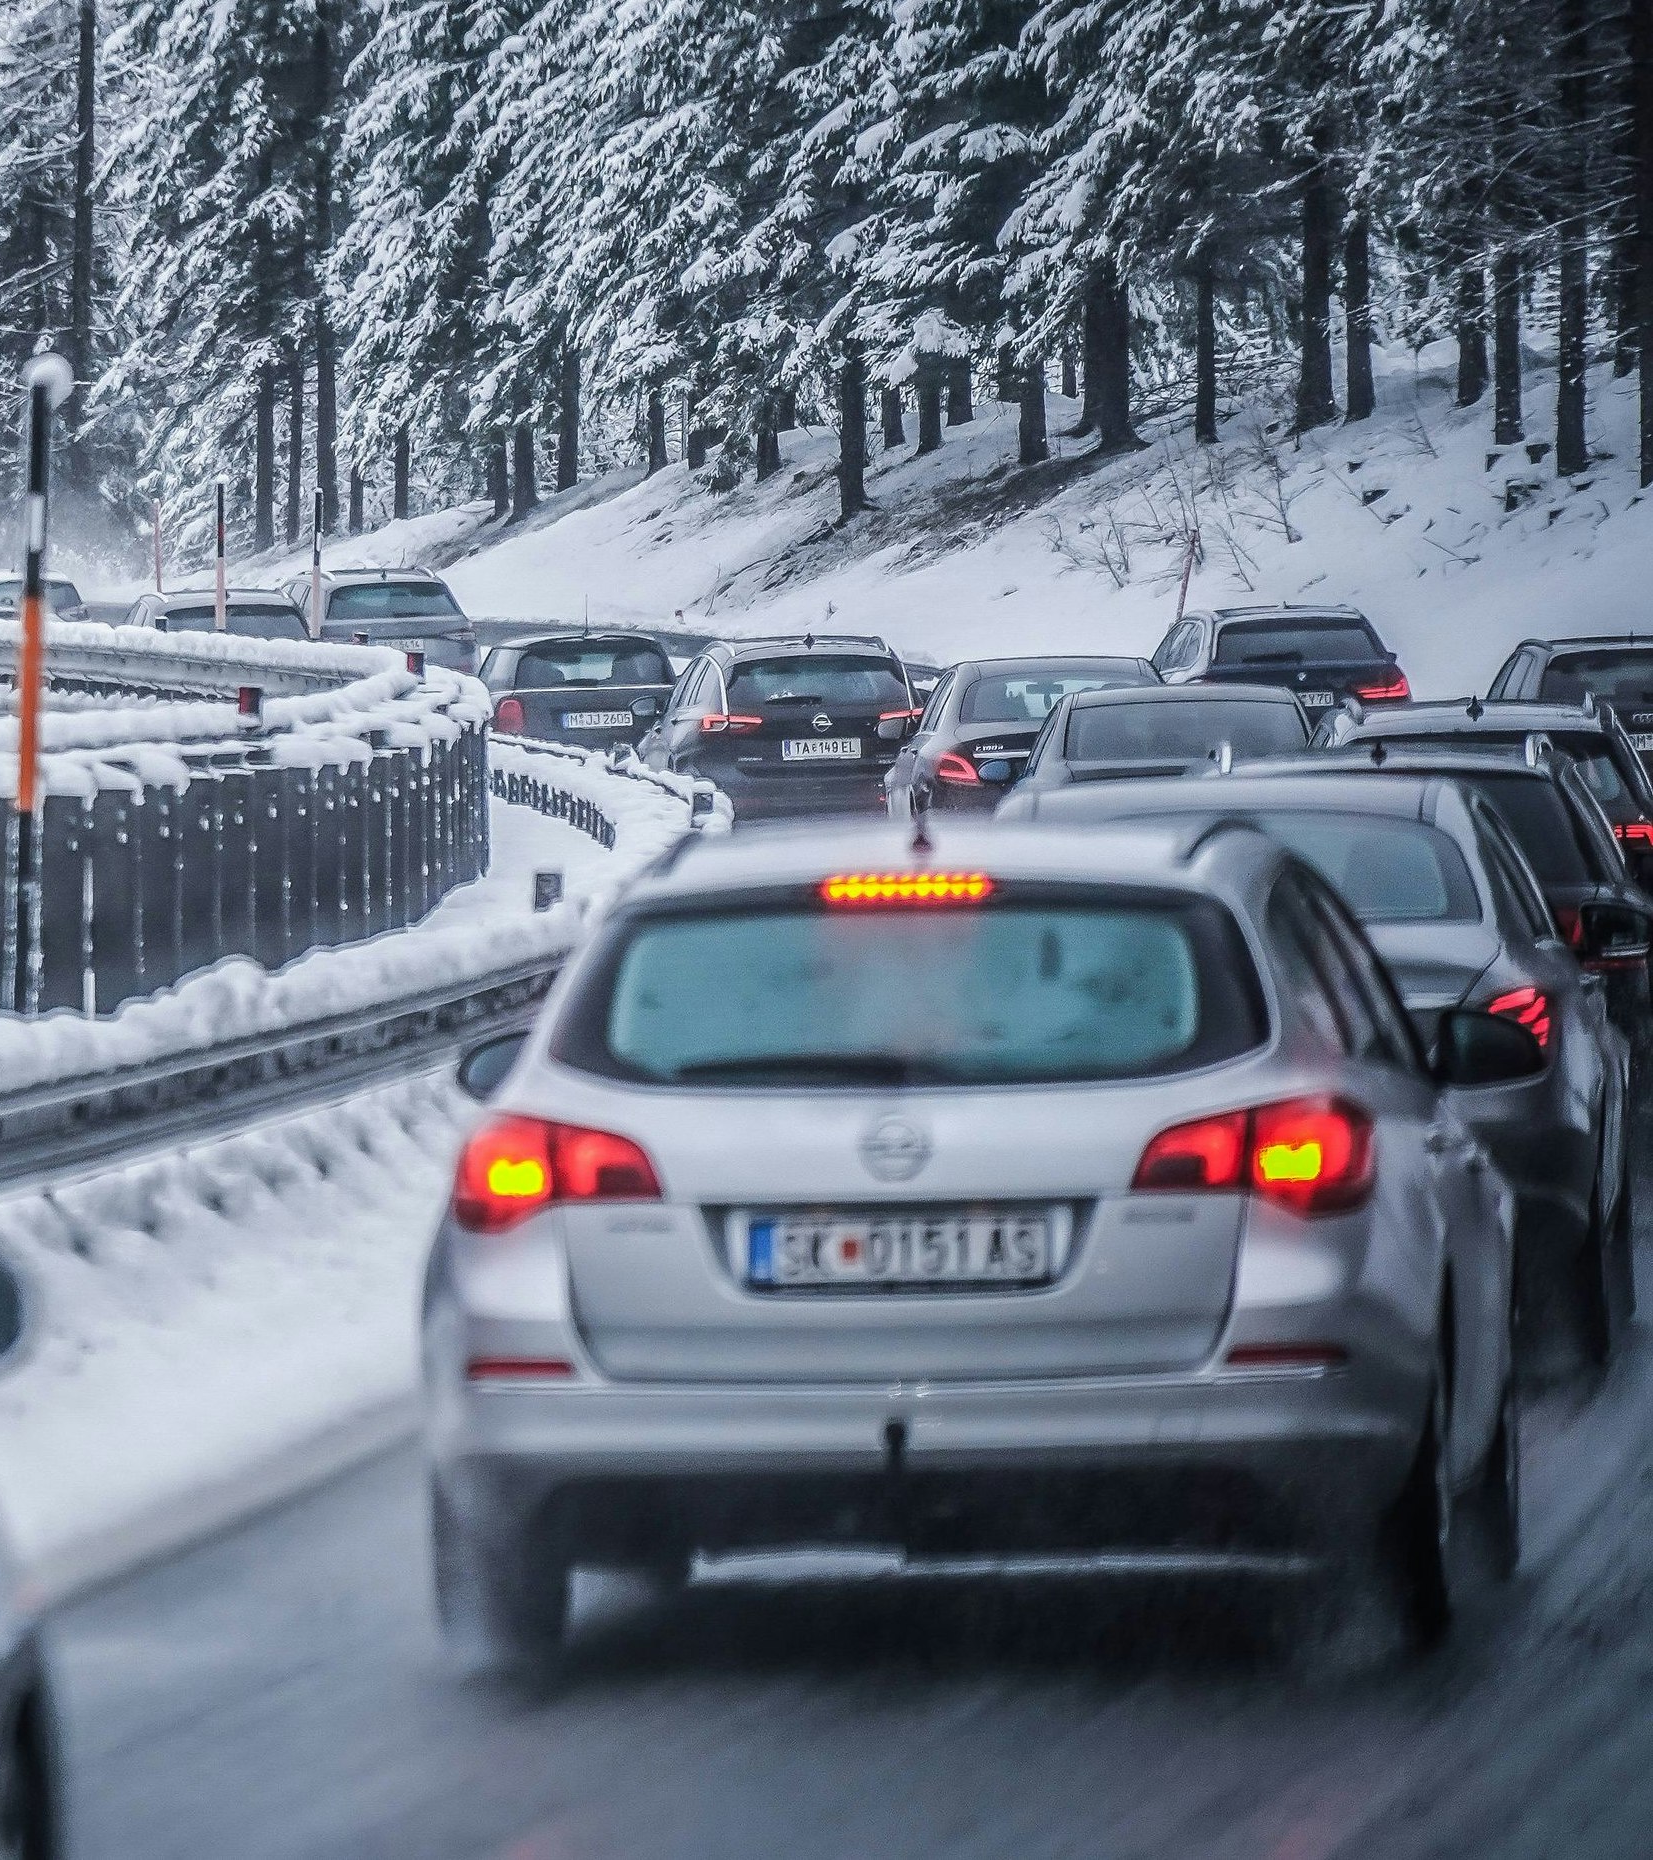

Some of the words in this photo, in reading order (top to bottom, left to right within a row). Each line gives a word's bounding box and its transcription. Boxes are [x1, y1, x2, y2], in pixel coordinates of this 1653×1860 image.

[795, 742, 810, 755] TA
[818, 741, 839, 754] 149
[841, 741, 856, 753] EL
